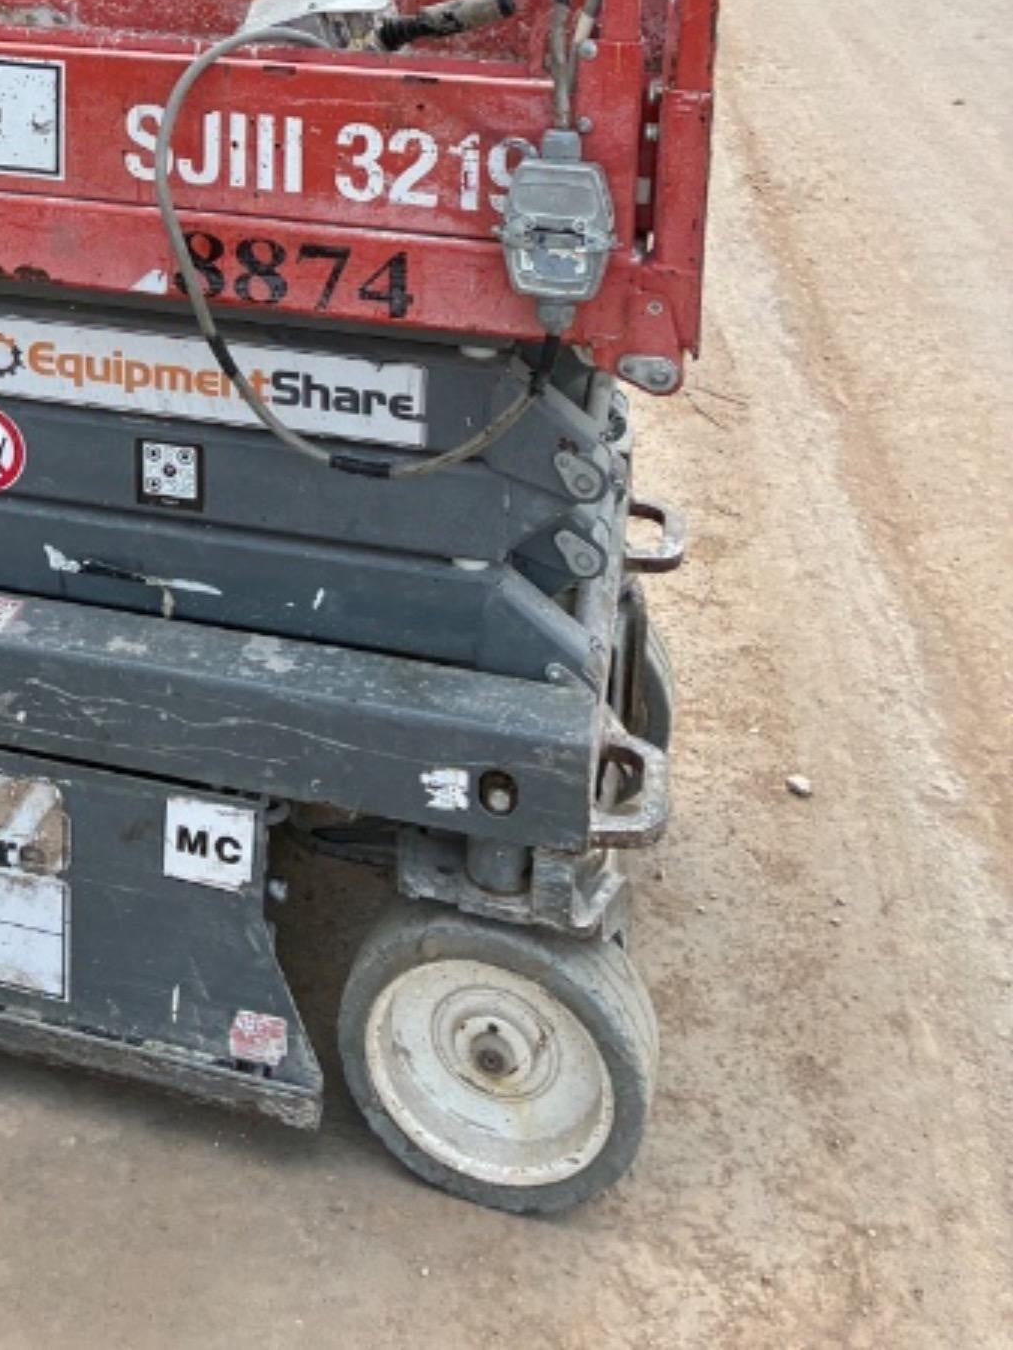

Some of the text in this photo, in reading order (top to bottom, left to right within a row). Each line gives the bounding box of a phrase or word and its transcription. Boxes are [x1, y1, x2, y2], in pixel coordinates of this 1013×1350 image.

[124, 103, 540, 211] SJIII 3219
[175, 229, 415, 319] 8874
[28, 340, 416, 418] EquipmentShare
[176, 824, 243, 865] MC
